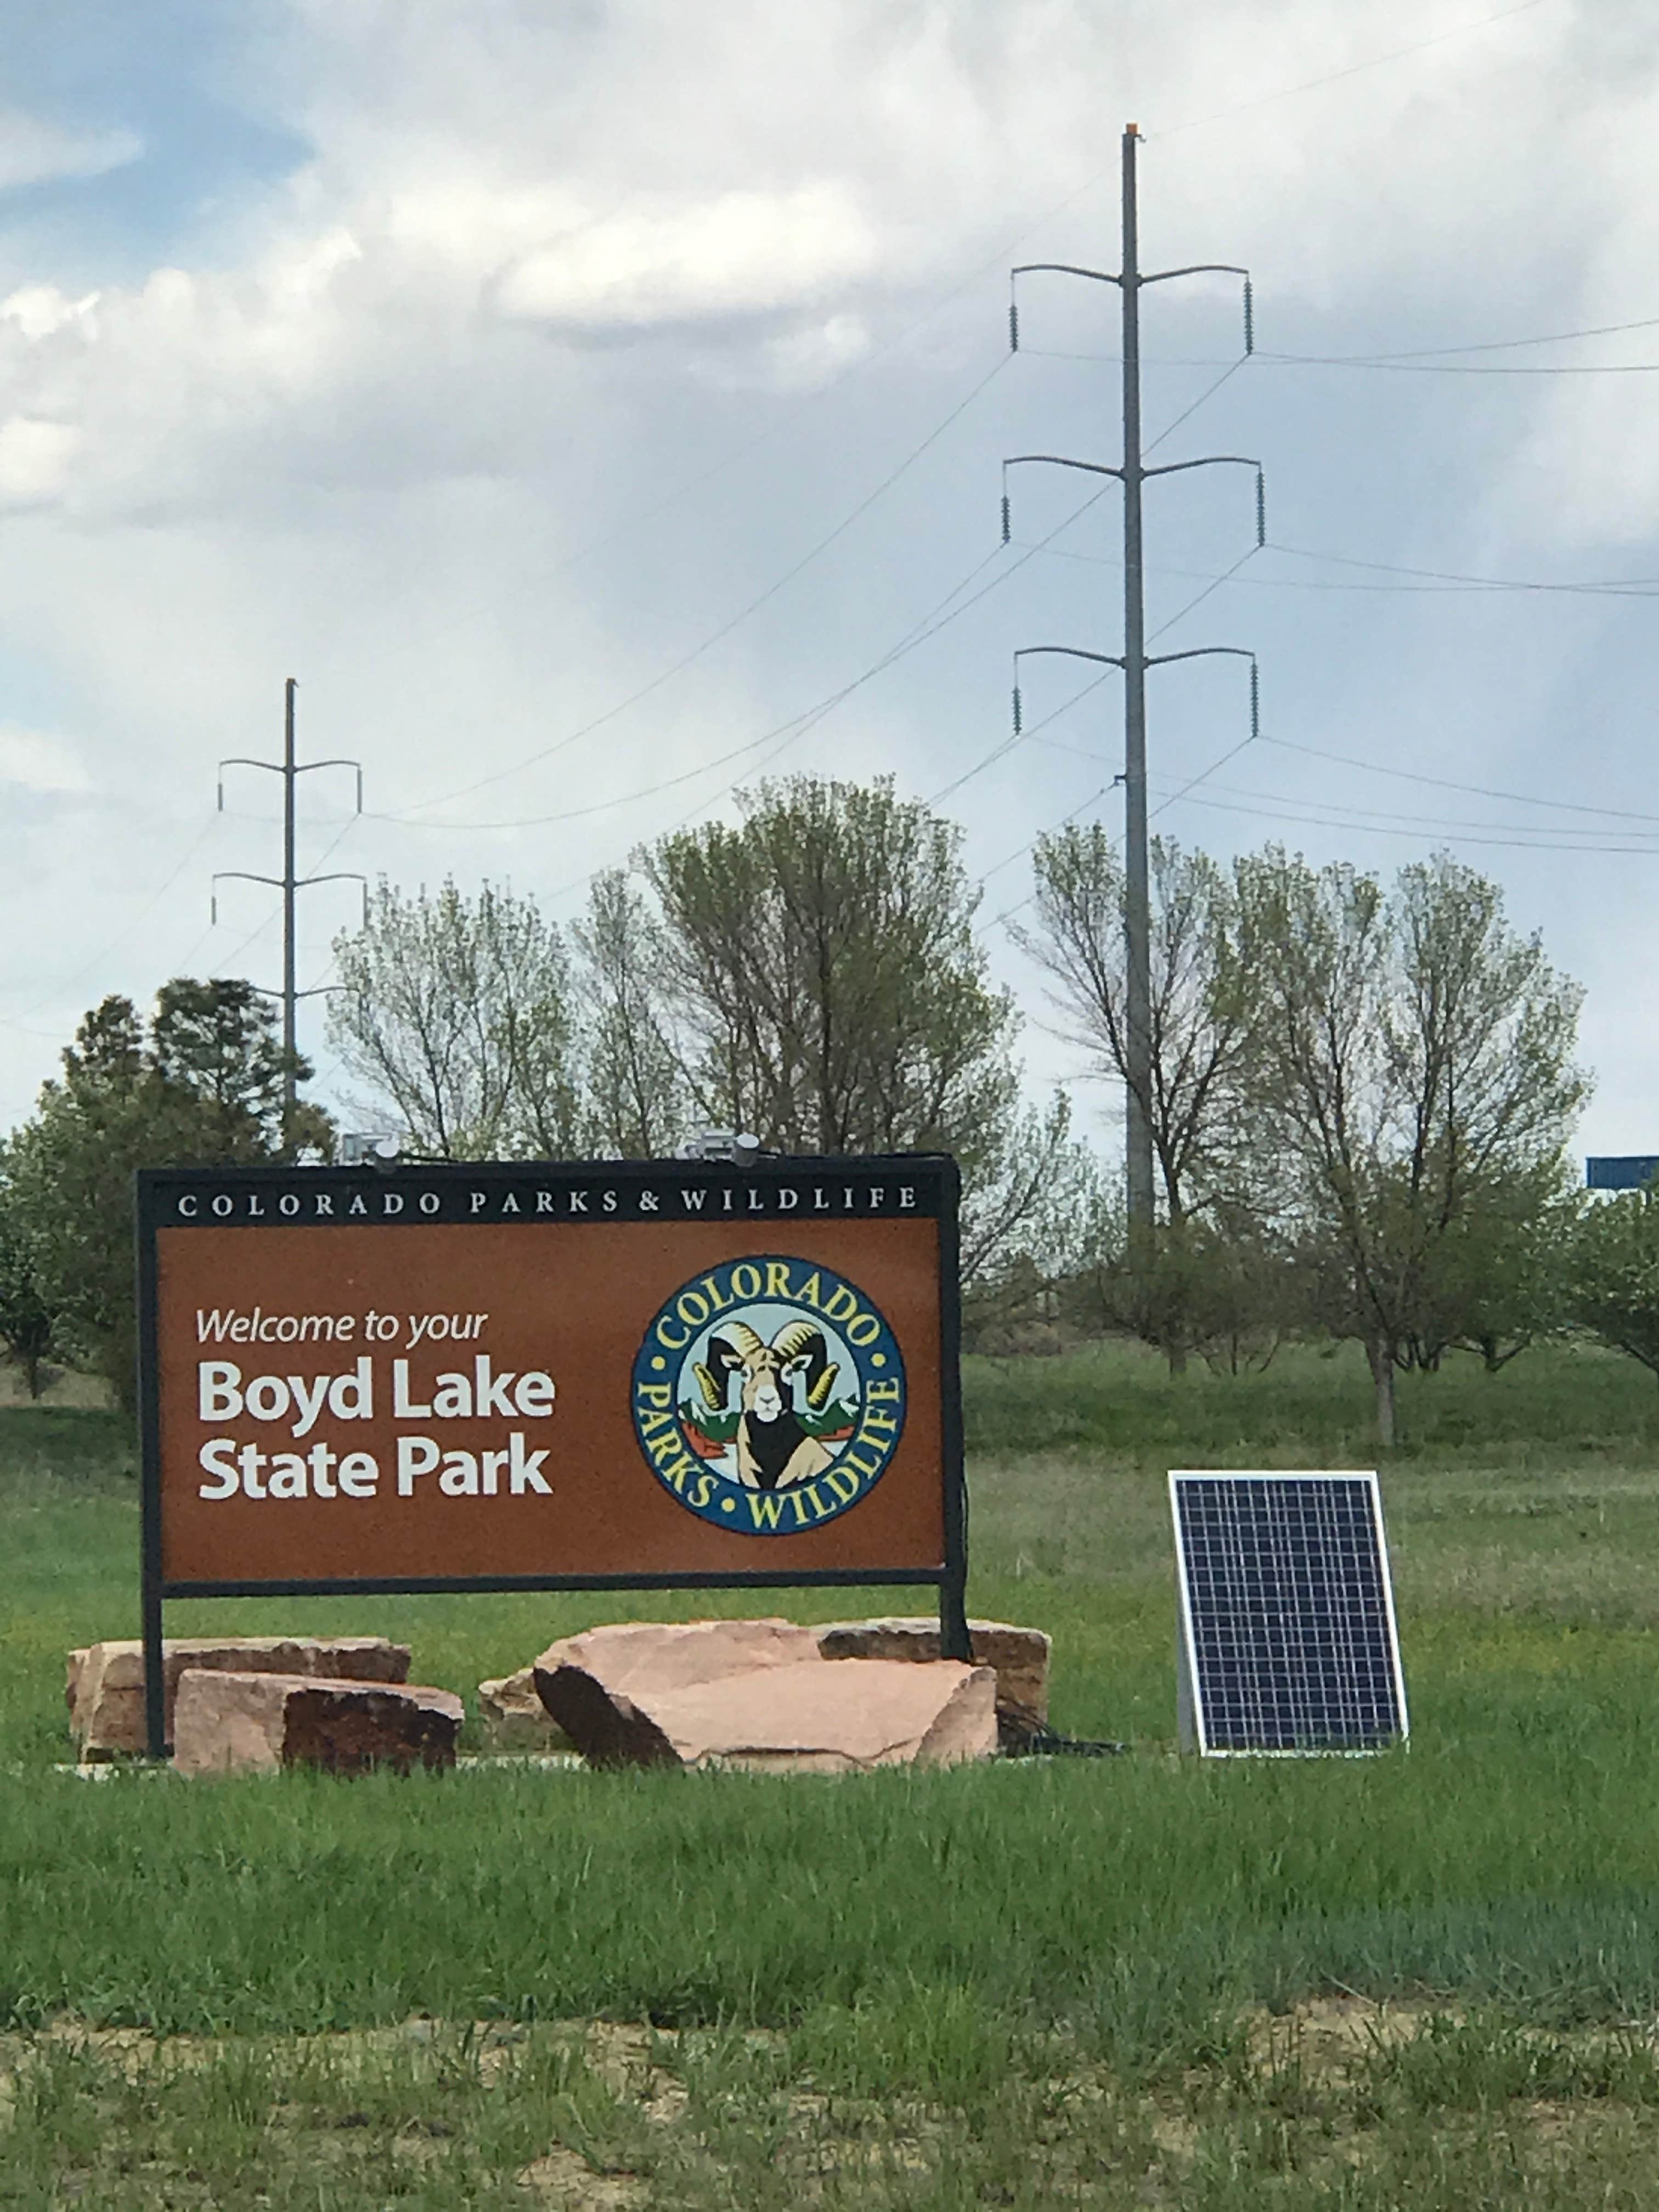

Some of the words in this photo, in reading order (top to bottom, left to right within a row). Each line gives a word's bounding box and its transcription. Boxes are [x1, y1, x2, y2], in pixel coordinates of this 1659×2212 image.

[178, 1193, 440, 1216] COLORADO
[470, 1190, 617, 1214] PARKS
[639, 1190, 659, 1211] &
[681, 1187, 916, 1210] WILDLIFE
[196, 1307, 356, 1342] Welcome
[364, 1310, 399, 1341] to
[406, 1314, 488, 1349] your
[656, 1262, 880, 1350] COLORADO
[199, 1356, 373, 1437] Boyd
[393, 1355, 555, 1418] Lake
[199, 1438, 379, 1499] State
[397, 1432, 553, 1497] Park
[637, 1382, 719, 1508] PARKS
[746, 1377, 900, 1530] WILDLIFE
